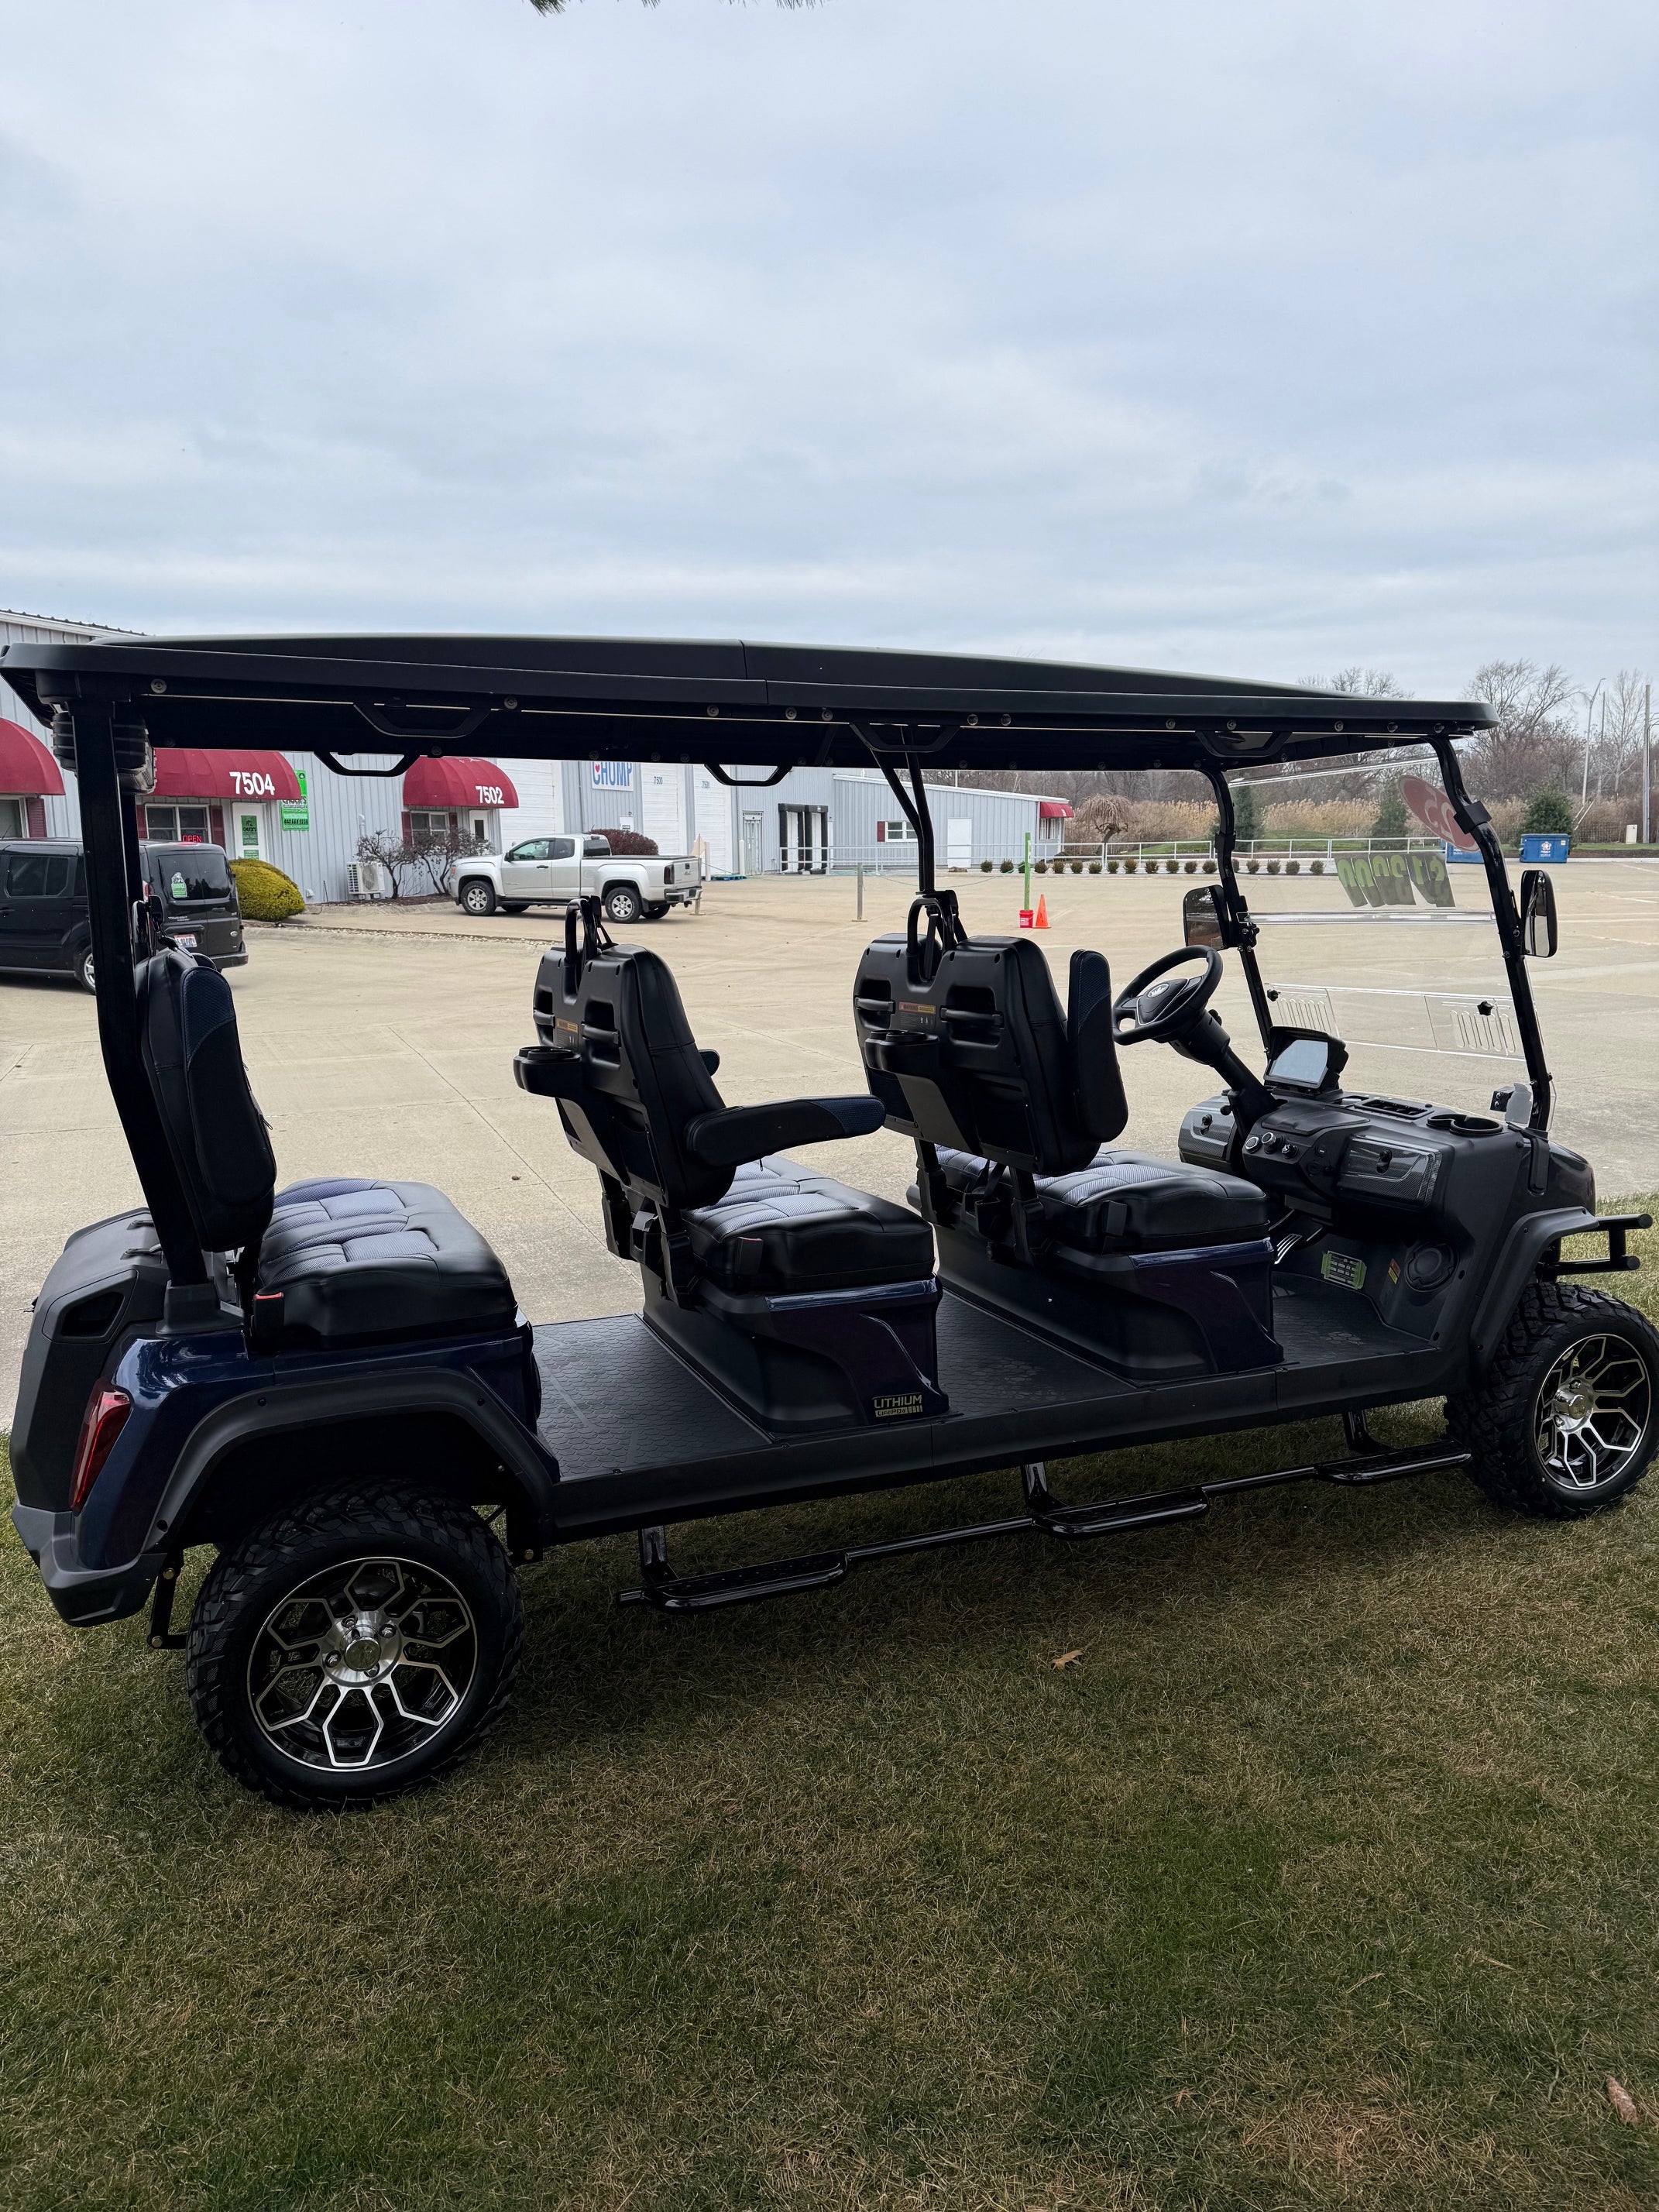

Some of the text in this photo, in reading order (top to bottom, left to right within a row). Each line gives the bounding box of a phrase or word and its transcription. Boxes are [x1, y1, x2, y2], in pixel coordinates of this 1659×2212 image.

[229, 771, 275, 795] 7504
[475, 785, 505, 804] 7502
[874, 1394, 922, 1409] LITHIUM
